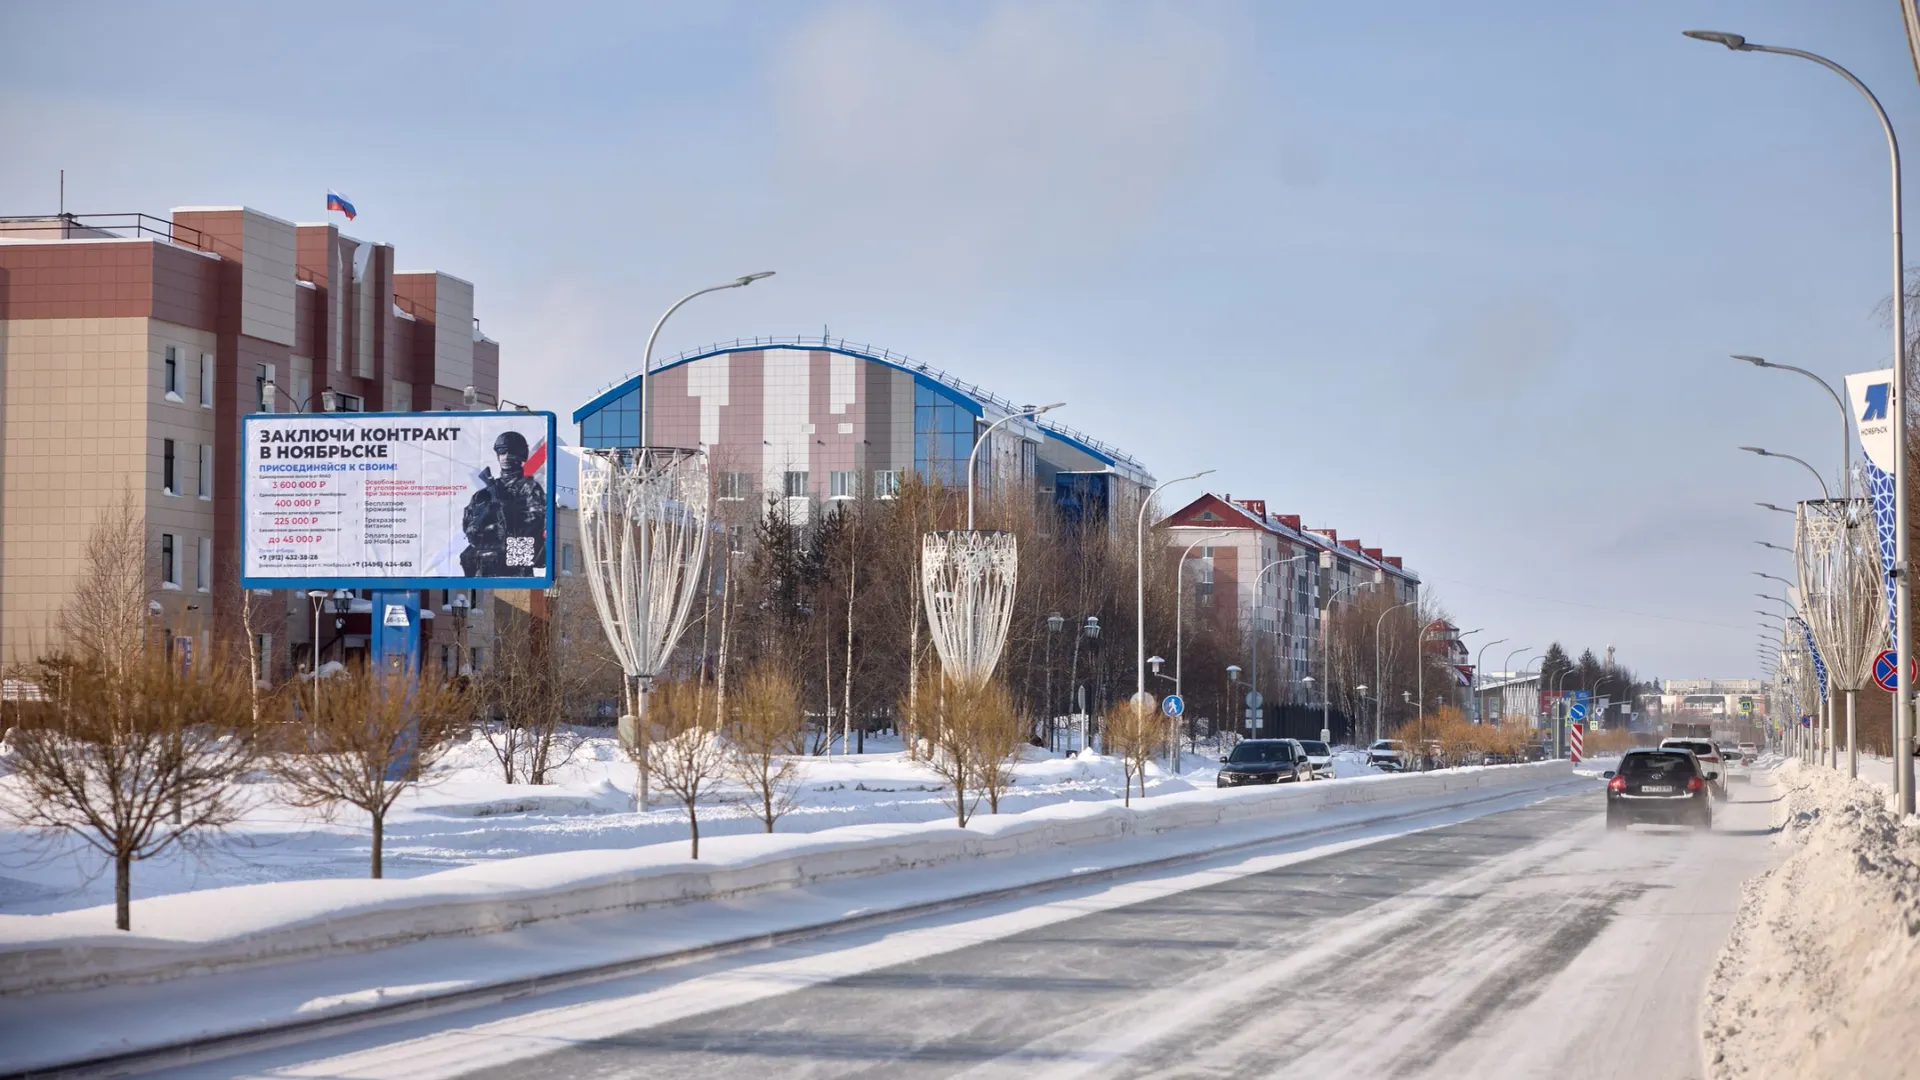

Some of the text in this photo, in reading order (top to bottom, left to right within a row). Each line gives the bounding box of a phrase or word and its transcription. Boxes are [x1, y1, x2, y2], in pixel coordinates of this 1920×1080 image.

[260, 428, 461, 443] ЗАКЛЮЧИ КОНТРАКТ
[260, 445, 388, 459] В НОЯБРЬСКЕ
[259, 462, 346, 472] ПРИСОЕДИНЯЙСЯ
[359, 463, 398, 471] СВОИМ!
